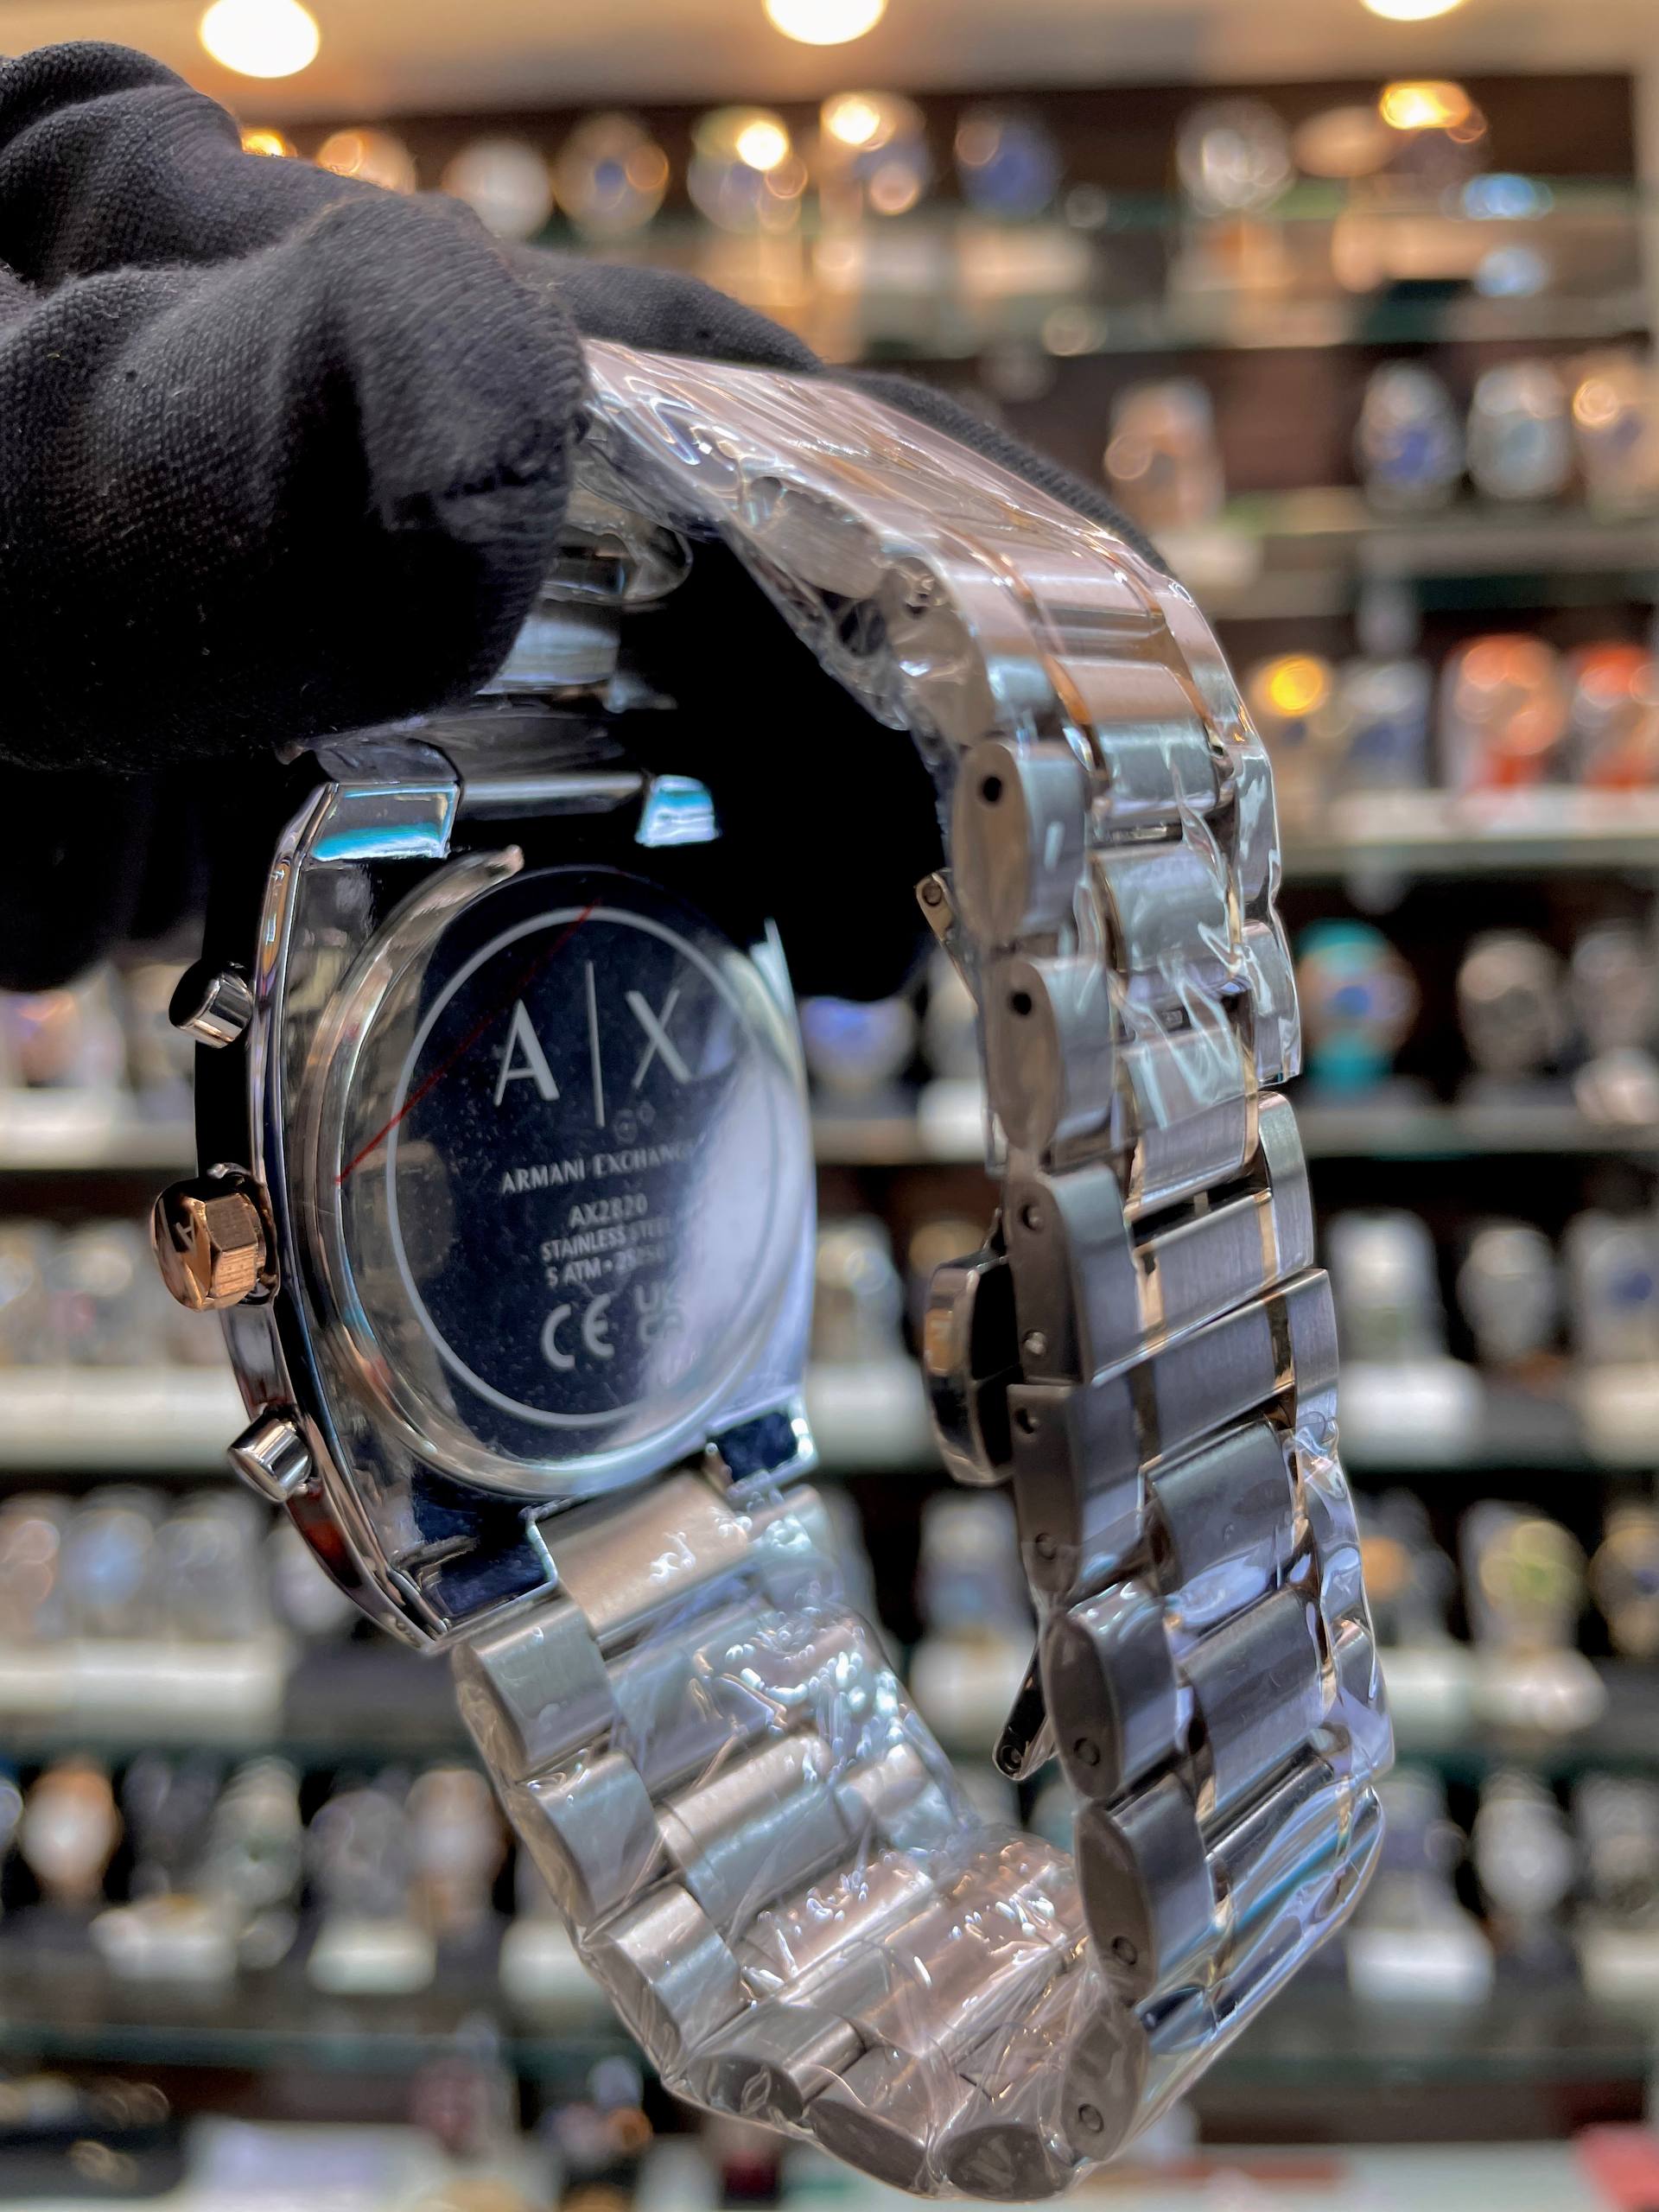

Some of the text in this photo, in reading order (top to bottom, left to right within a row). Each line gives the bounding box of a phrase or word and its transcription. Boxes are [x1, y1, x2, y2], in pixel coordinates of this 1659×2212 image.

[500, 1158, 585, 1195] ARMANI
[542, 1223, 626, 1262] STAINLESS
[563, 1256, 602, 1283] ATM
